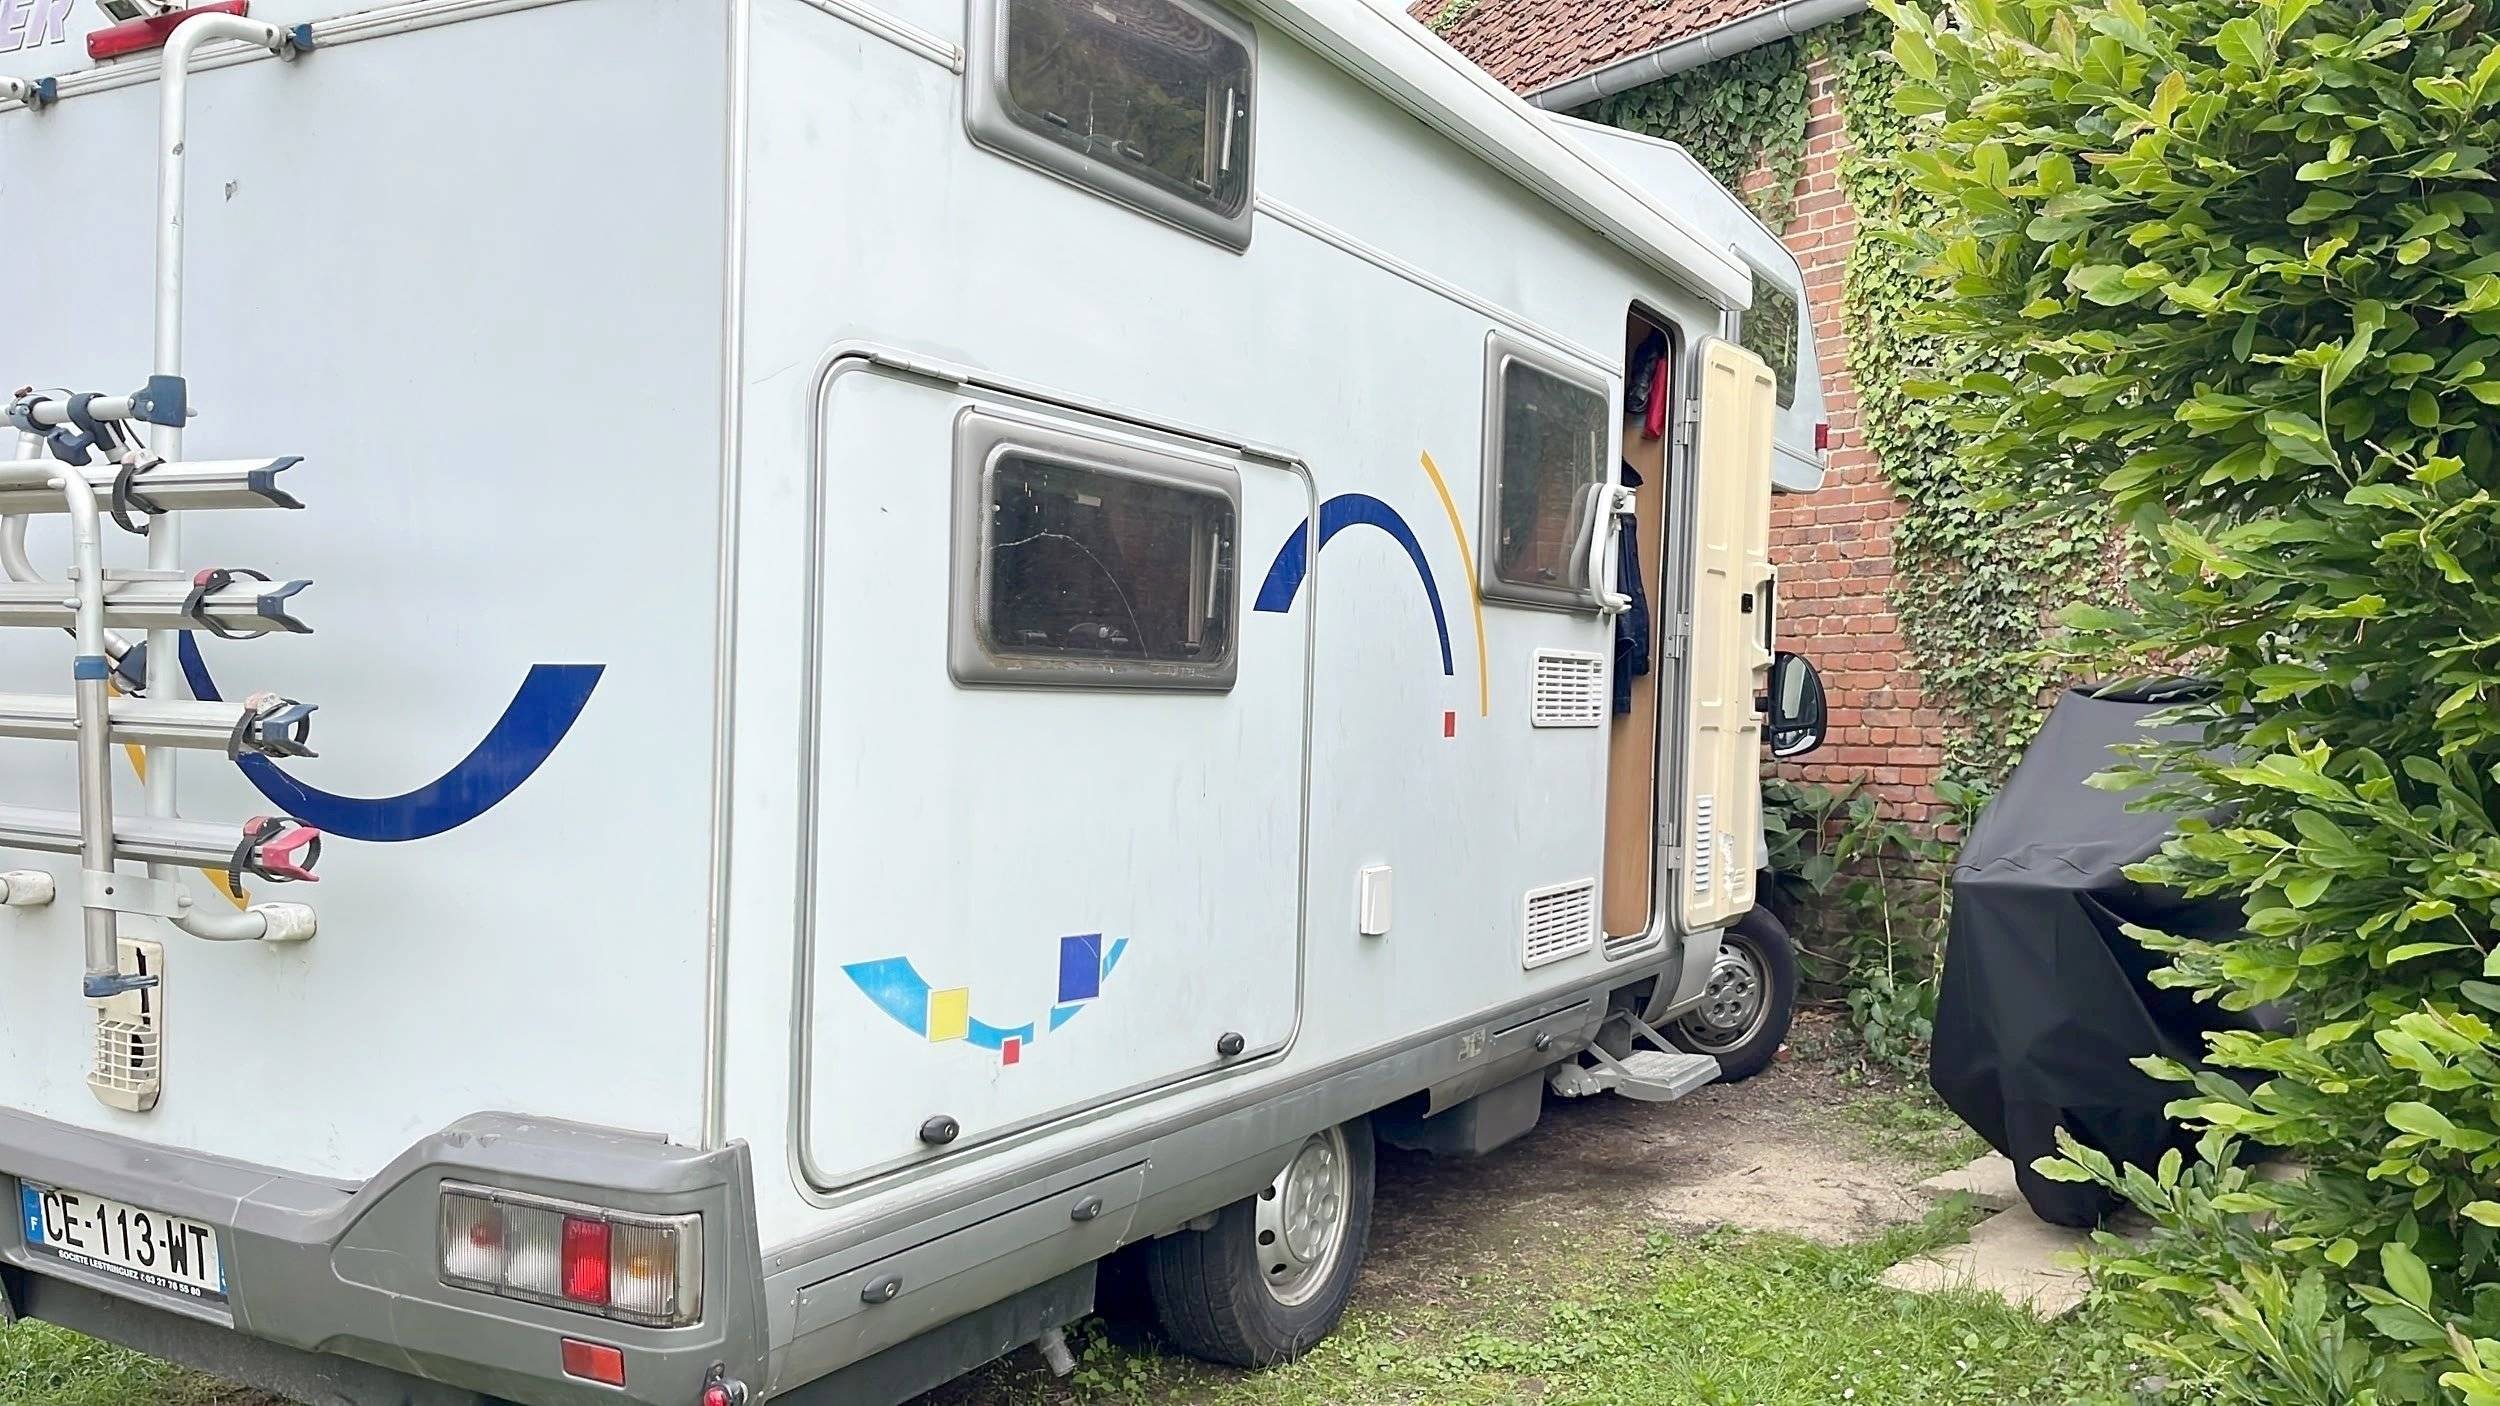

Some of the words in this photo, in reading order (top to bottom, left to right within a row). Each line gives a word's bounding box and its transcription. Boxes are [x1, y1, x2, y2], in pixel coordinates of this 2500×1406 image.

[30, 1215, 39, 1231] F
[43, 1191, 209, 1281] CE-113-WT
[58, 1249, 90, 1266] SOCIETE
